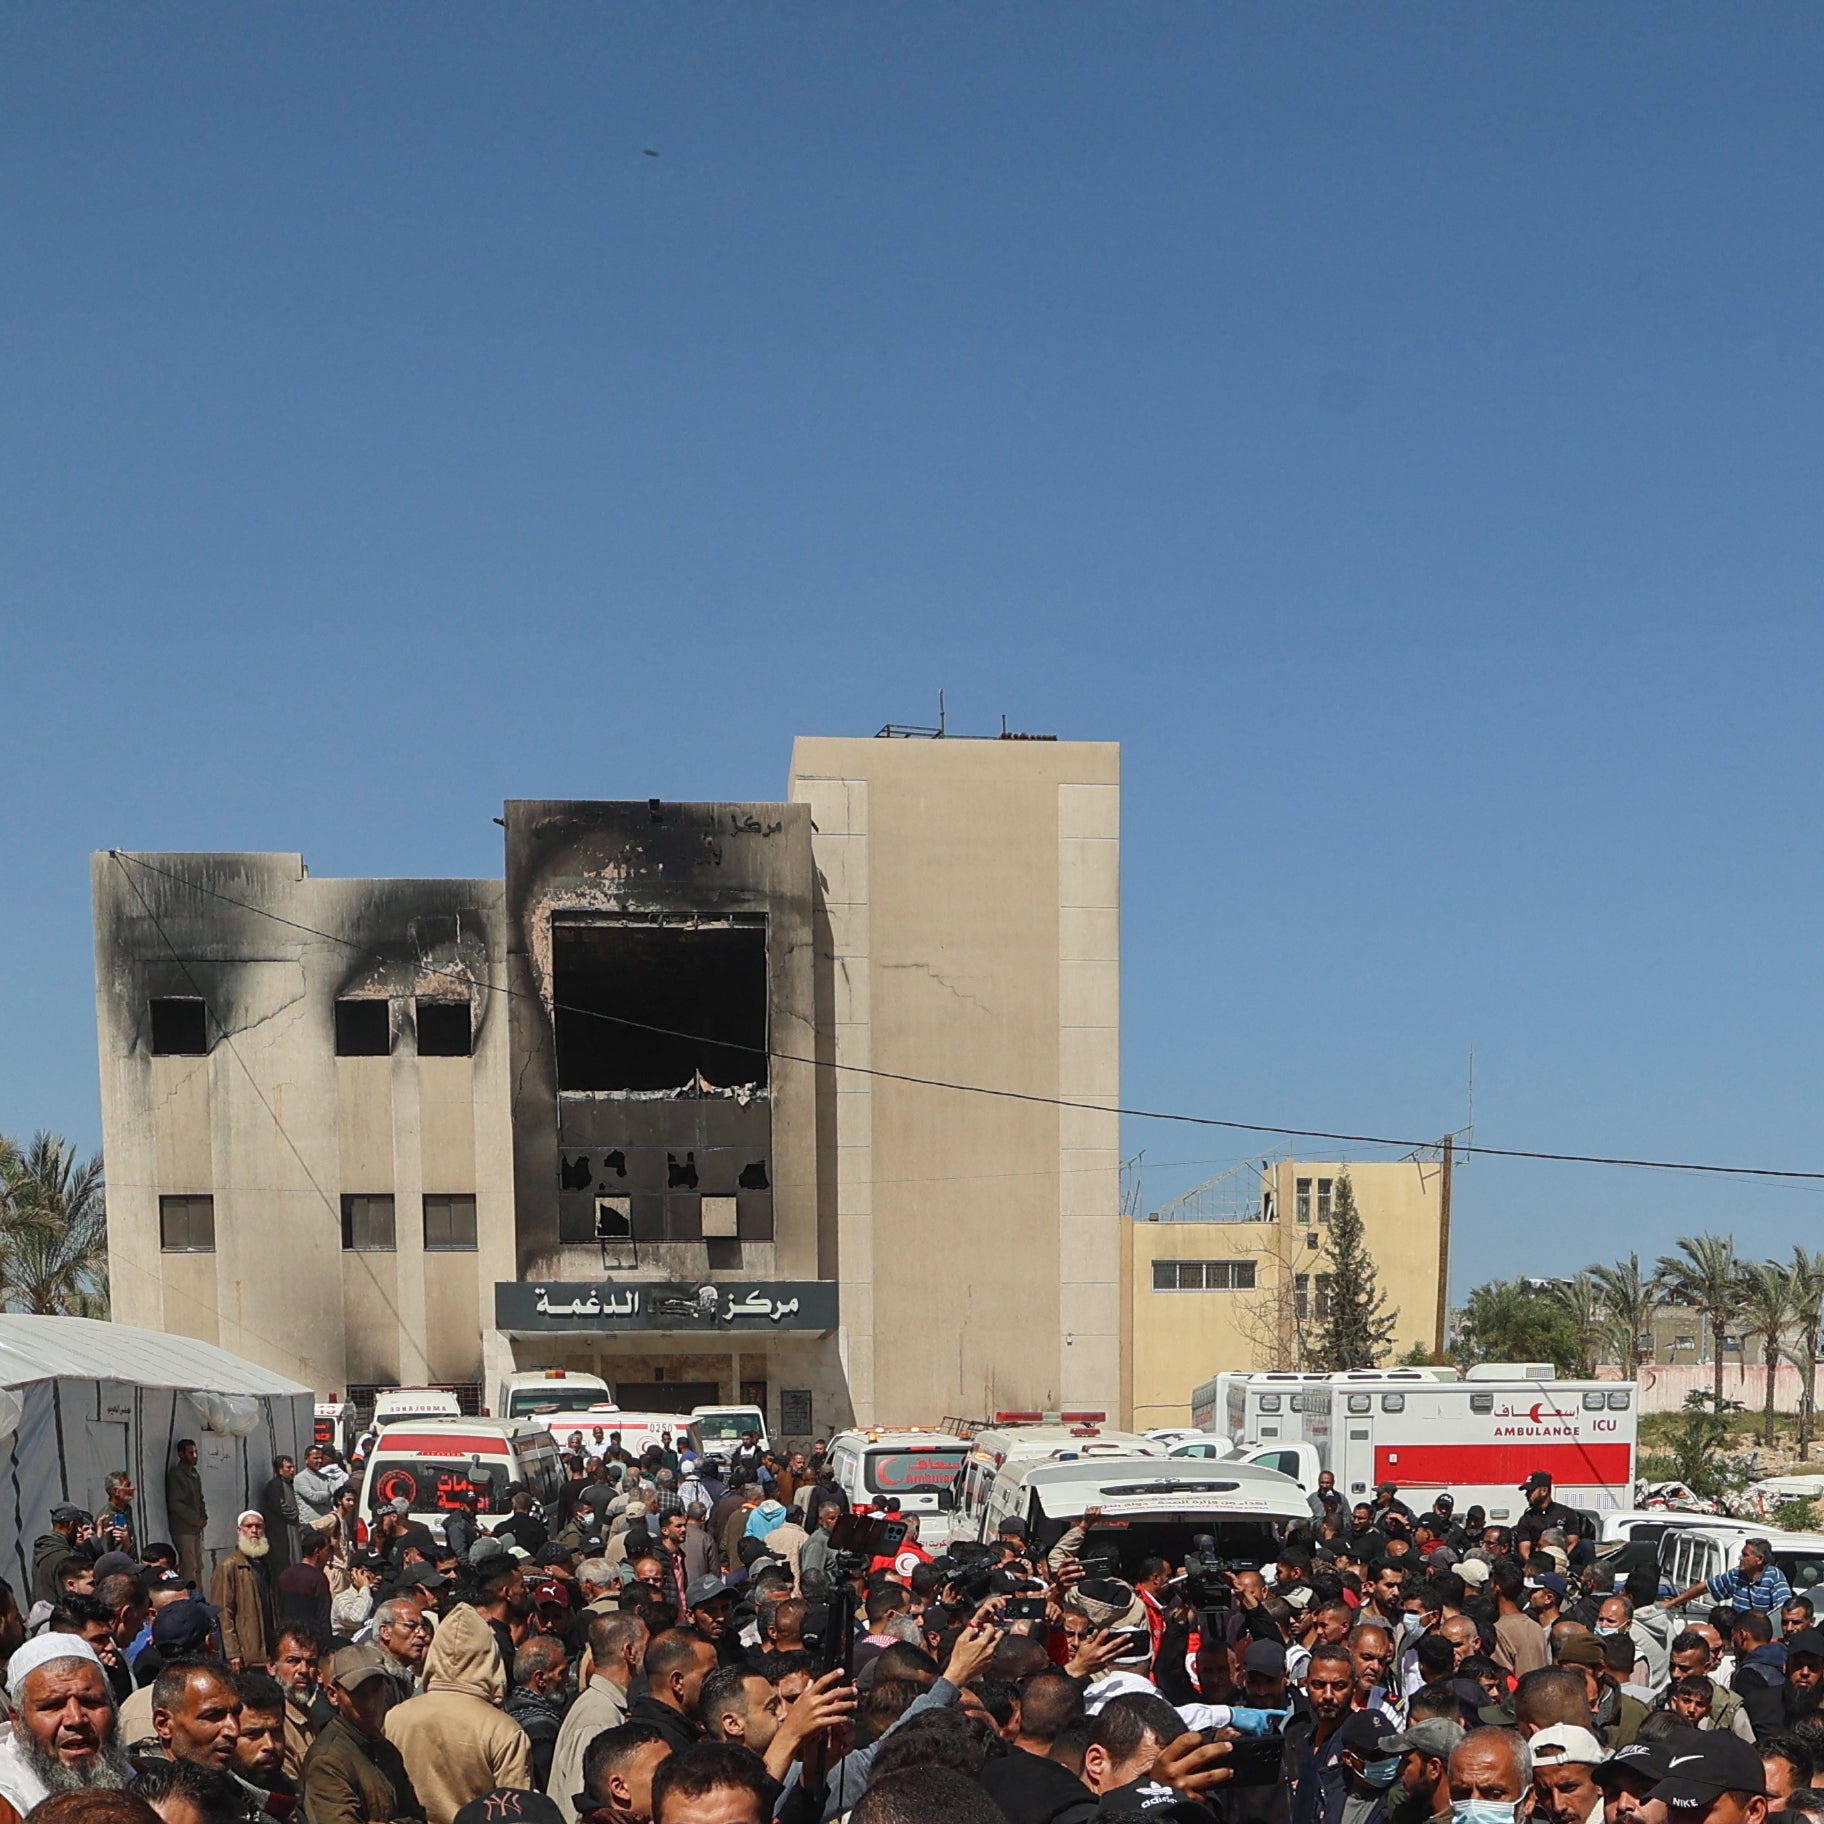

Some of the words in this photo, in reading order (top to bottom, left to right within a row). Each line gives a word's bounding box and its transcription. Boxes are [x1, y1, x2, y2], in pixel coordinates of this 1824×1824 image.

[534, 1288, 639, 1315] الدغمة
[722, 1289, 800, 1321] مركز
[1494, 1427, 1580, 1436] AMBULANCE
[1592, 1420, 1617, 1431] ICU
[482, 1790, 523, 1821] NY
[1672, 1797, 1699, 1808] NIKE
